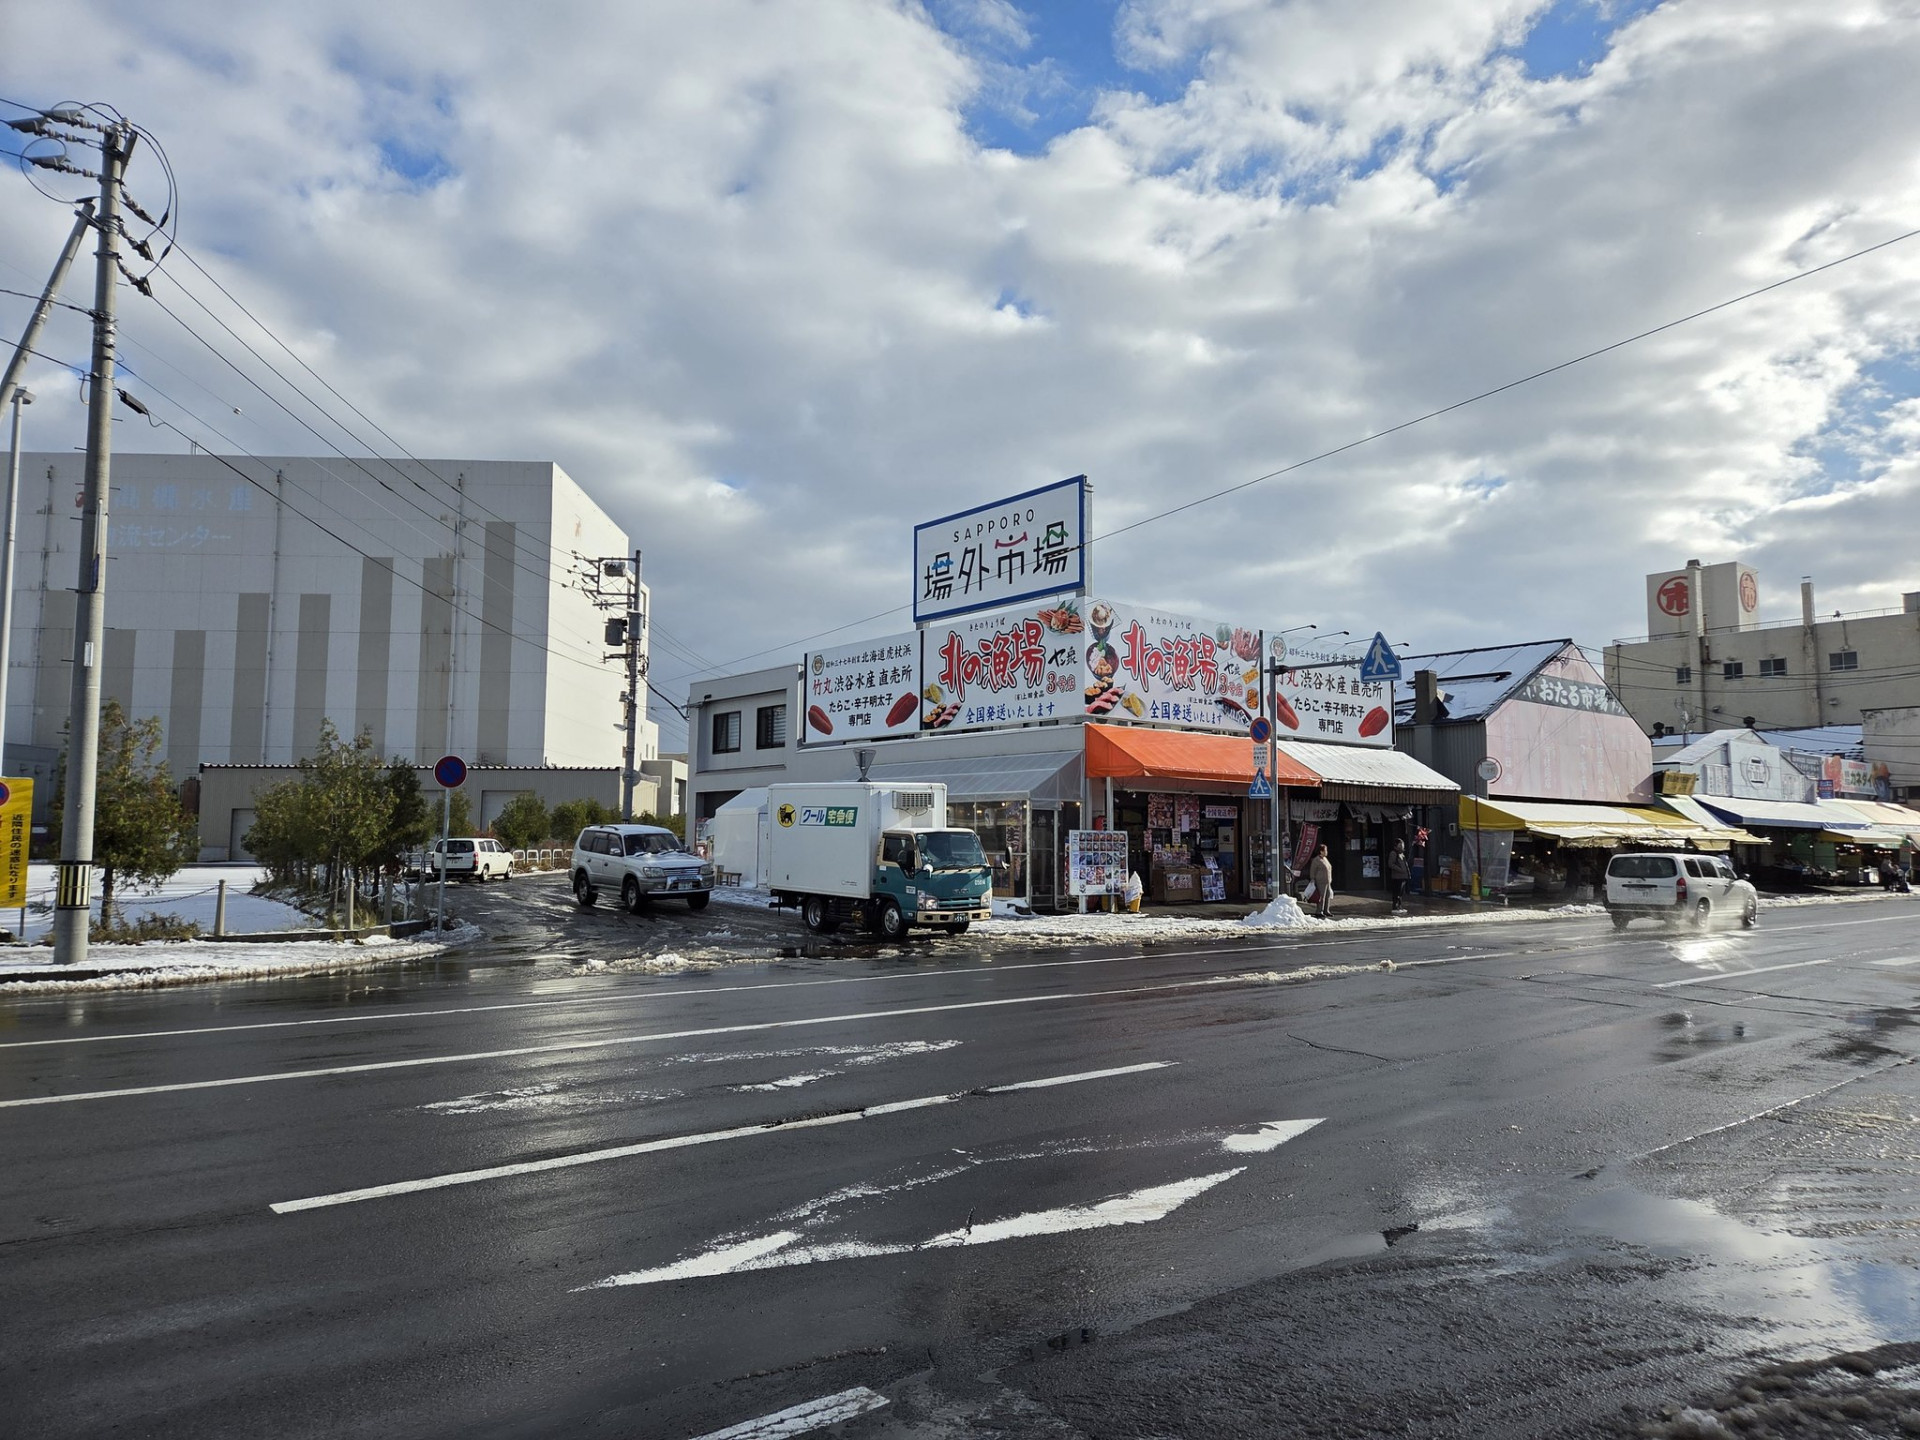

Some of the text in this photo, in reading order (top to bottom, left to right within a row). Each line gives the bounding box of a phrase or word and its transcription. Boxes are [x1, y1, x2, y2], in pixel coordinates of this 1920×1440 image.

[953, 509, 1035, 543] SAPPORO
[924, 520, 1069, 601] 場外市場
[861, 644, 912, 663] 北海道虎杖浜
[938, 618, 1047, 702] 北の漁場
[1121, 619, 1219, 694] 北の漁場
[1046, 670, 1076, 694] 3号店
[829, 693, 893, 713] たらこ・辛子明太子
[966, 702, 1055, 725] 全国発送いたします
[1150, 700, 1223, 726] 全国発送いたします
[1294, 696, 1365, 718] たらこ・辛子明太子
[848, 713, 872, 727] 専門店
[1318, 718, 1344, 734] 専門店
